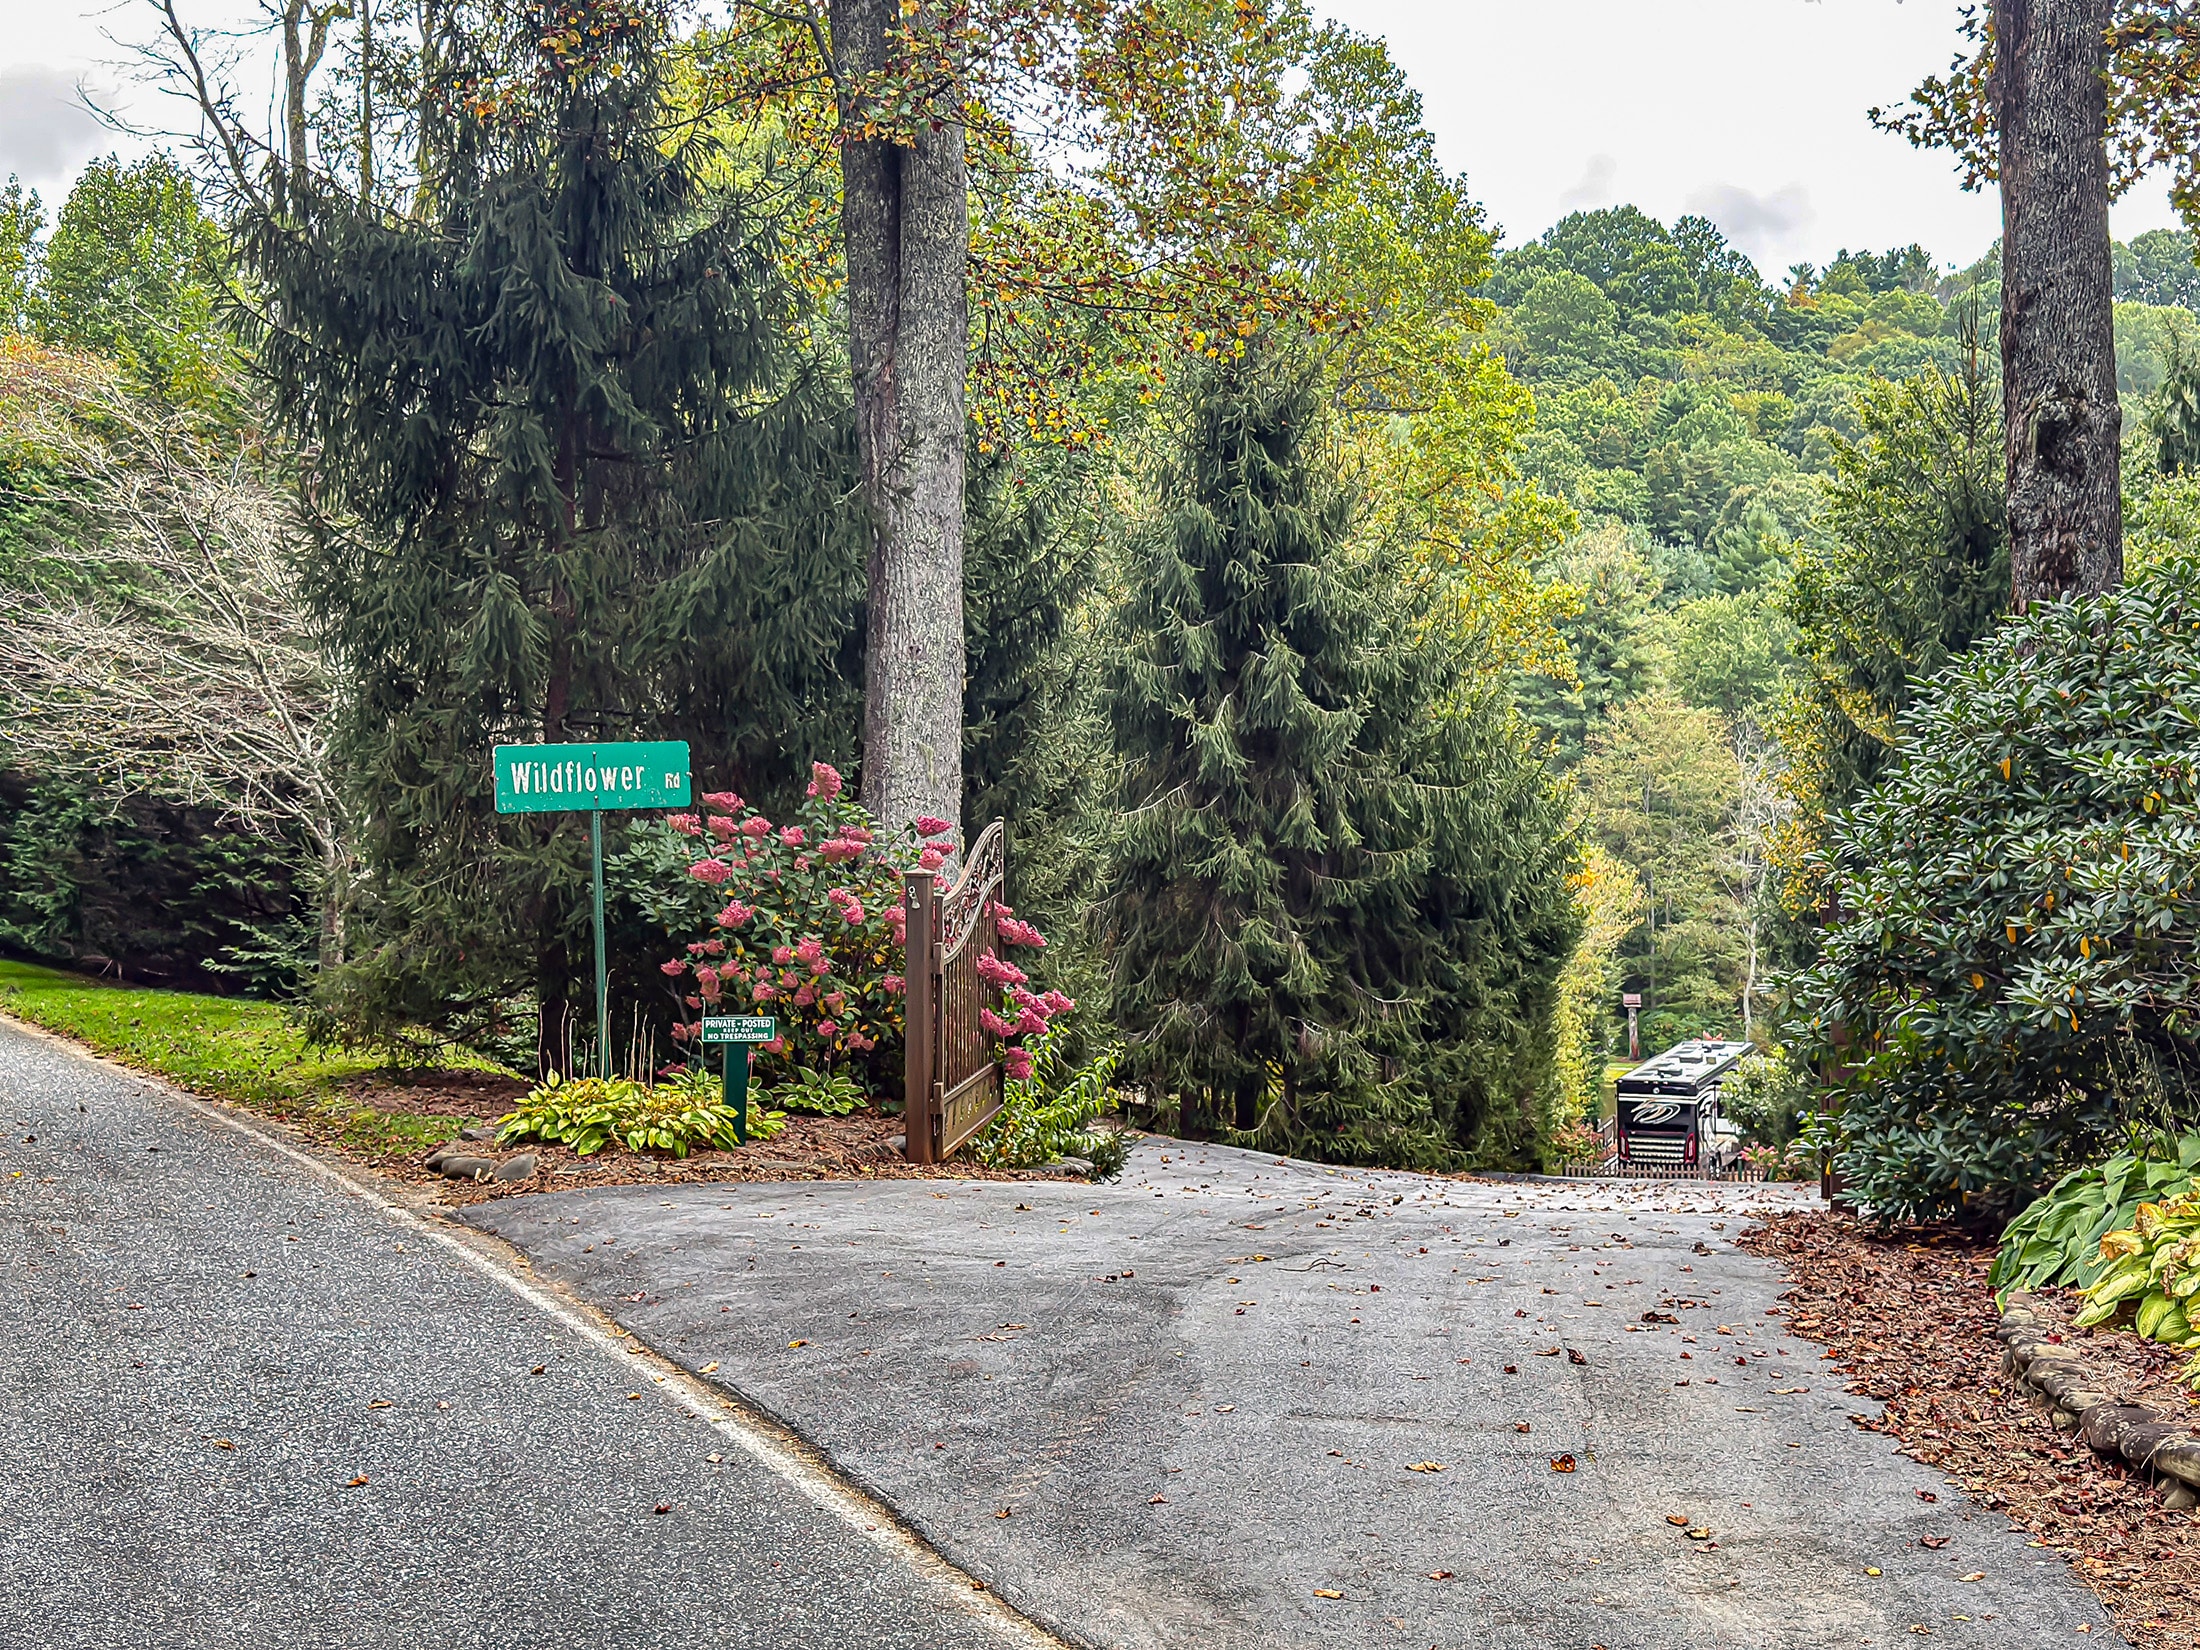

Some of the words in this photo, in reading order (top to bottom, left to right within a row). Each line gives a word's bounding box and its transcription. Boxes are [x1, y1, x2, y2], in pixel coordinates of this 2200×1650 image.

[511, 761, 645, 794] Wildflower
[665, 772, 681, 789] Rd
[705, 1020, 736, 1028] PRIVATE
[742, 1020, 771, 1028] POSTED
